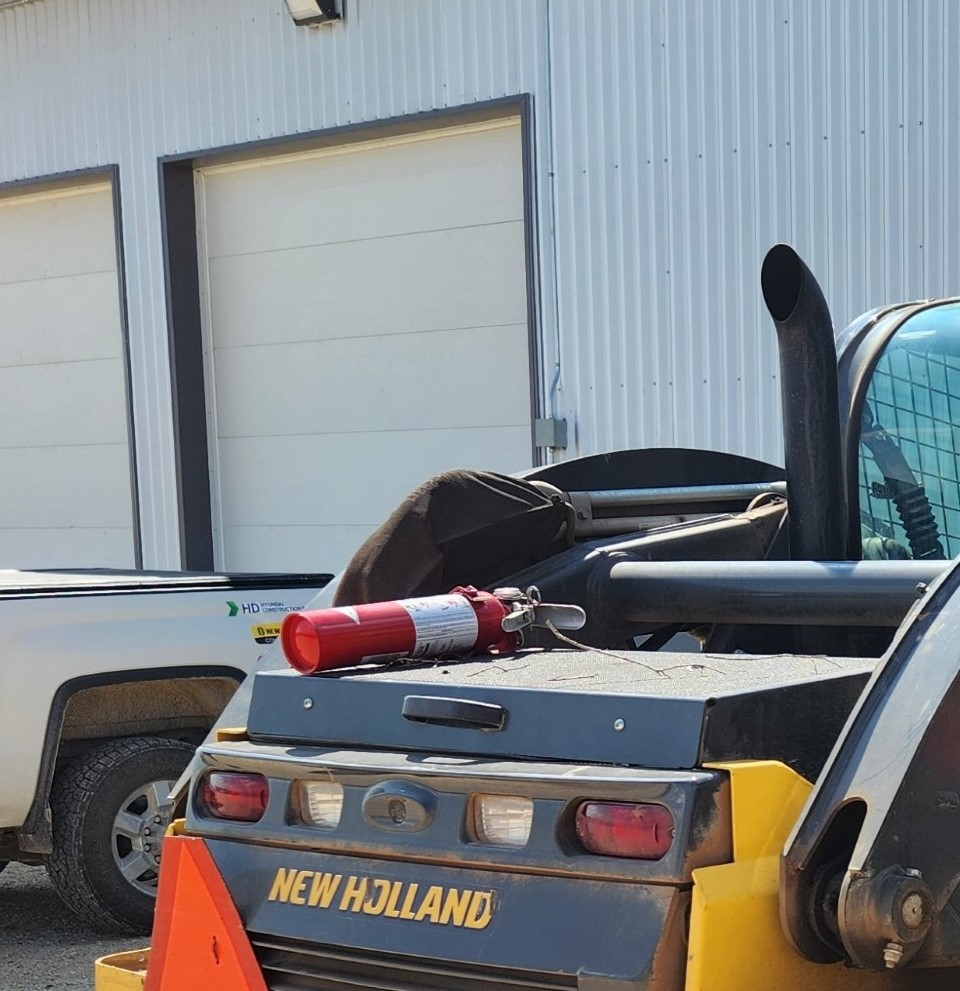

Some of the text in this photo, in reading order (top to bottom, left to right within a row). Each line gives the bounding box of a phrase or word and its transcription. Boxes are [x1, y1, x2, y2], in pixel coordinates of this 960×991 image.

[241, 603, 260, 614] HD
[267, 867, 494, 930] NEW HOLLAND
